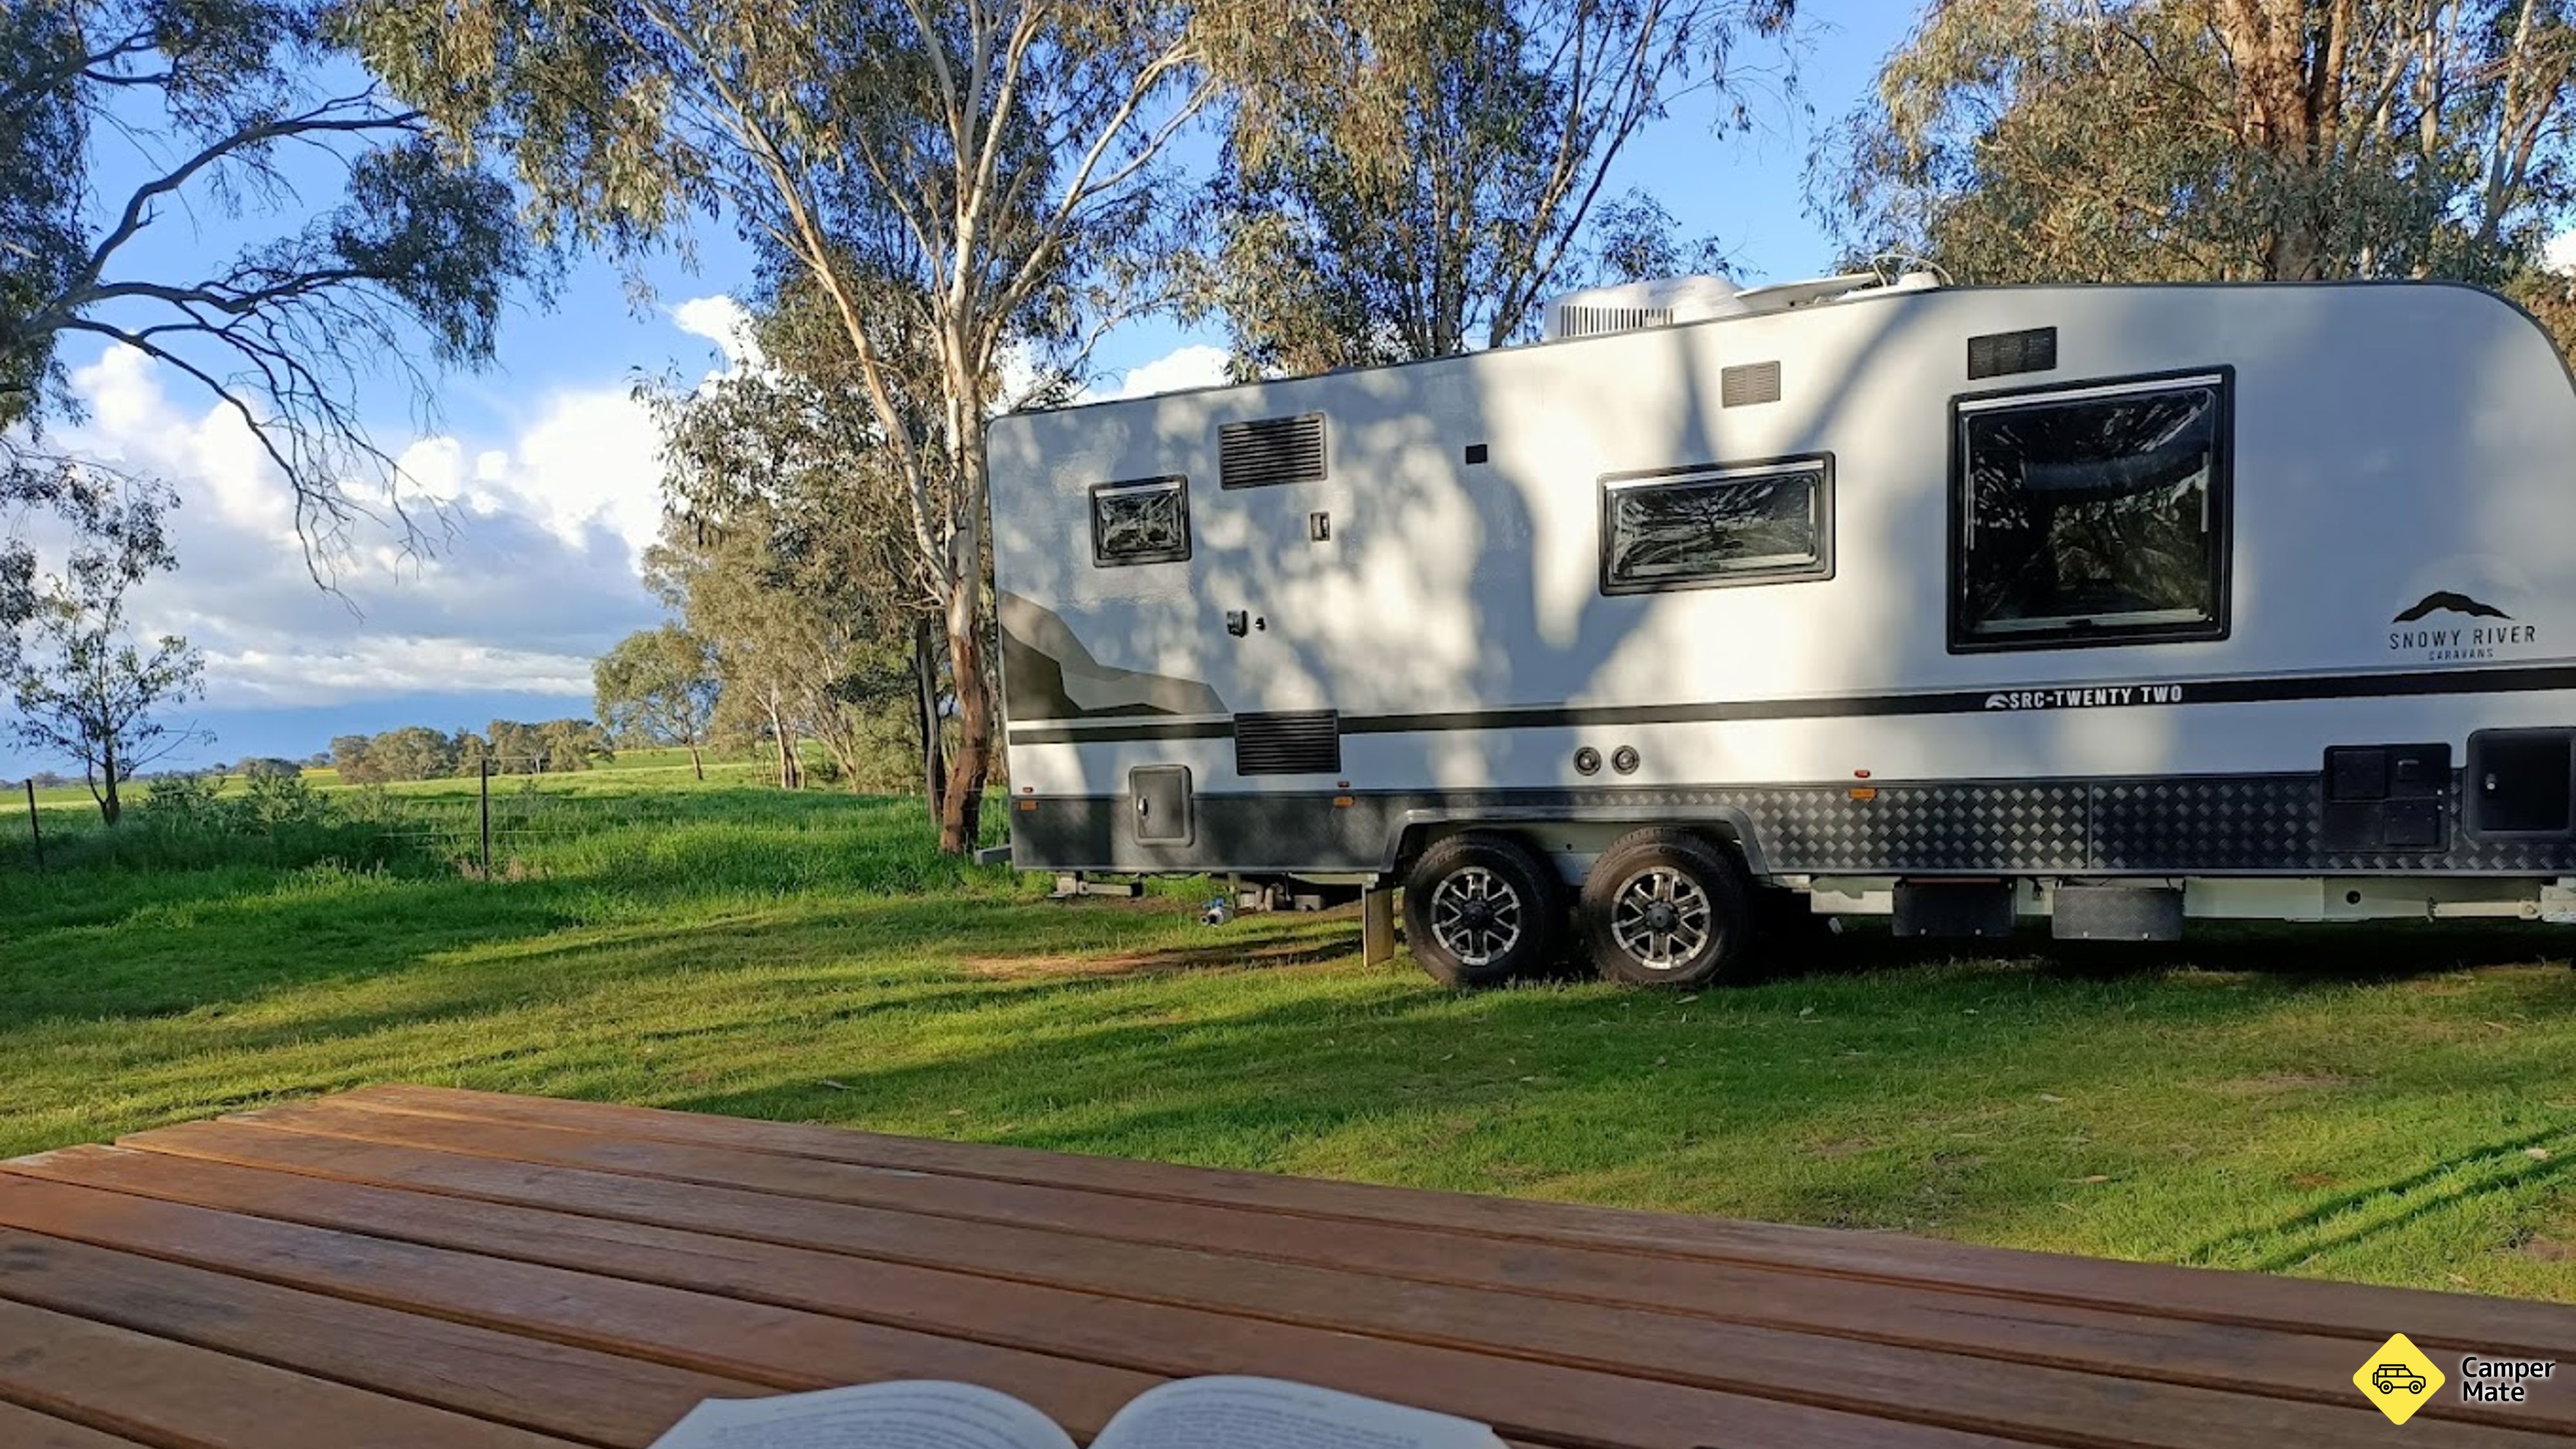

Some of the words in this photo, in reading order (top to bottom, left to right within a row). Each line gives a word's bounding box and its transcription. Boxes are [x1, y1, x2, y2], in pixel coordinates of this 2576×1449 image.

[2390, 629, 2461, 650] SNOWY
[2474, 625, 2536, 644] RIVER
[2429, 648, 2494, 661] CARAVANS
[2009, 688, 2132, 709] SRC-TWENTY
[2141, 685, 2183, 703] TWO
